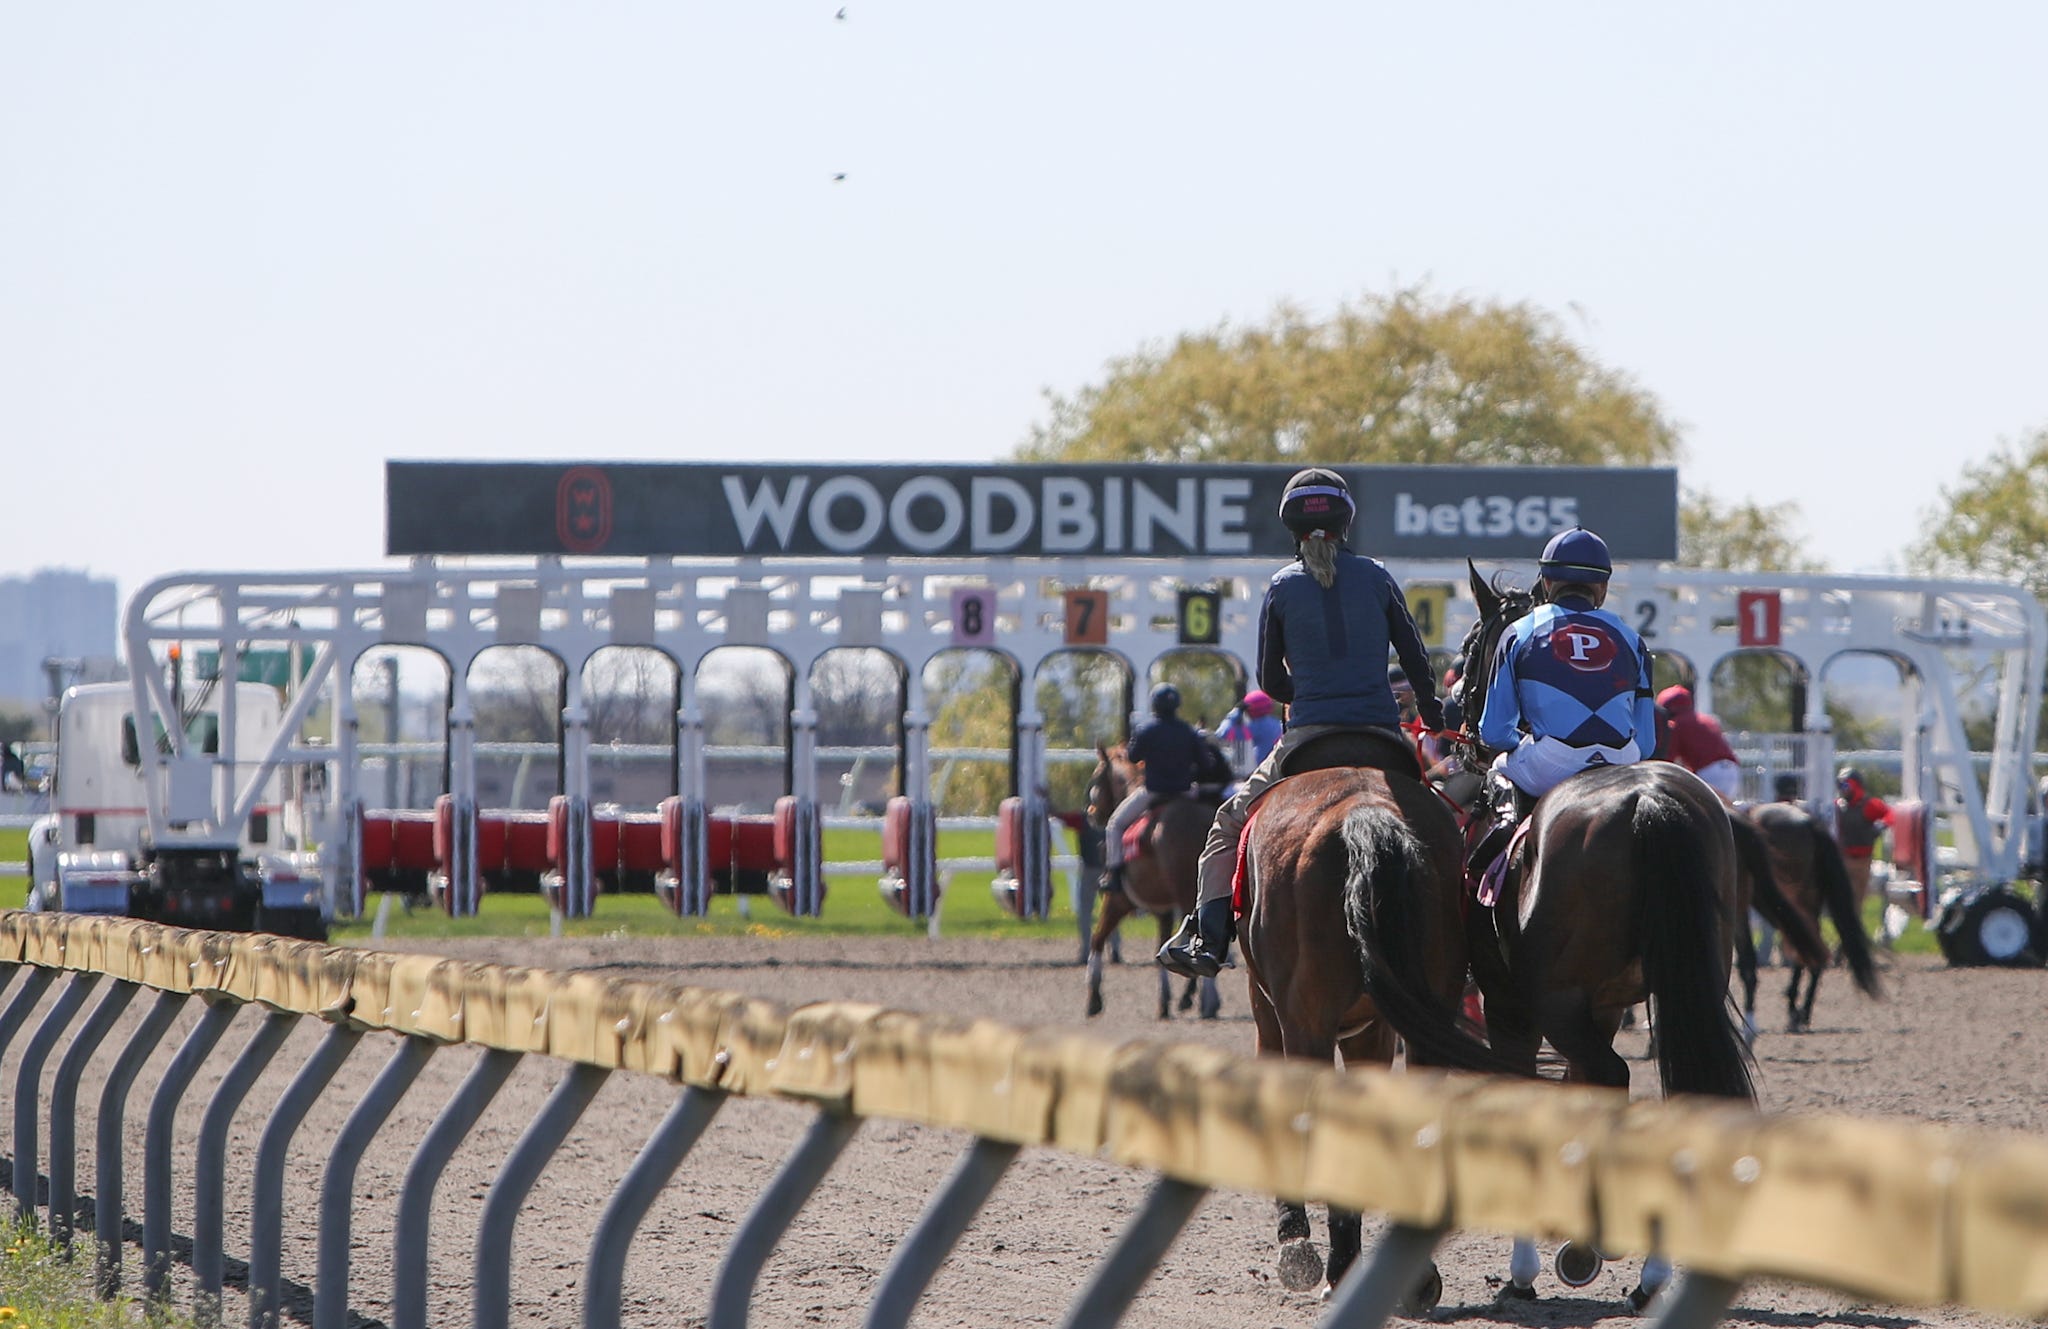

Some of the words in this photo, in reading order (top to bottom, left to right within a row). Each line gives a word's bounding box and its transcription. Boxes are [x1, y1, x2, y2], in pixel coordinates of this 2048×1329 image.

[722, 475, 1251, 552] WOODBINE
[1394, 493, 1580, 537] bet365
[961, 595, 984, 637] 8
[1074, 598, 1095, 637] 7
[1185, 595, 1212, 639] 6
[1416, 598, 1433, 637] 4
[1636, 600, 1658, 637] 2
[1750, 599, 1767, 640] 1
[1566, 632, 1600, 661] P
